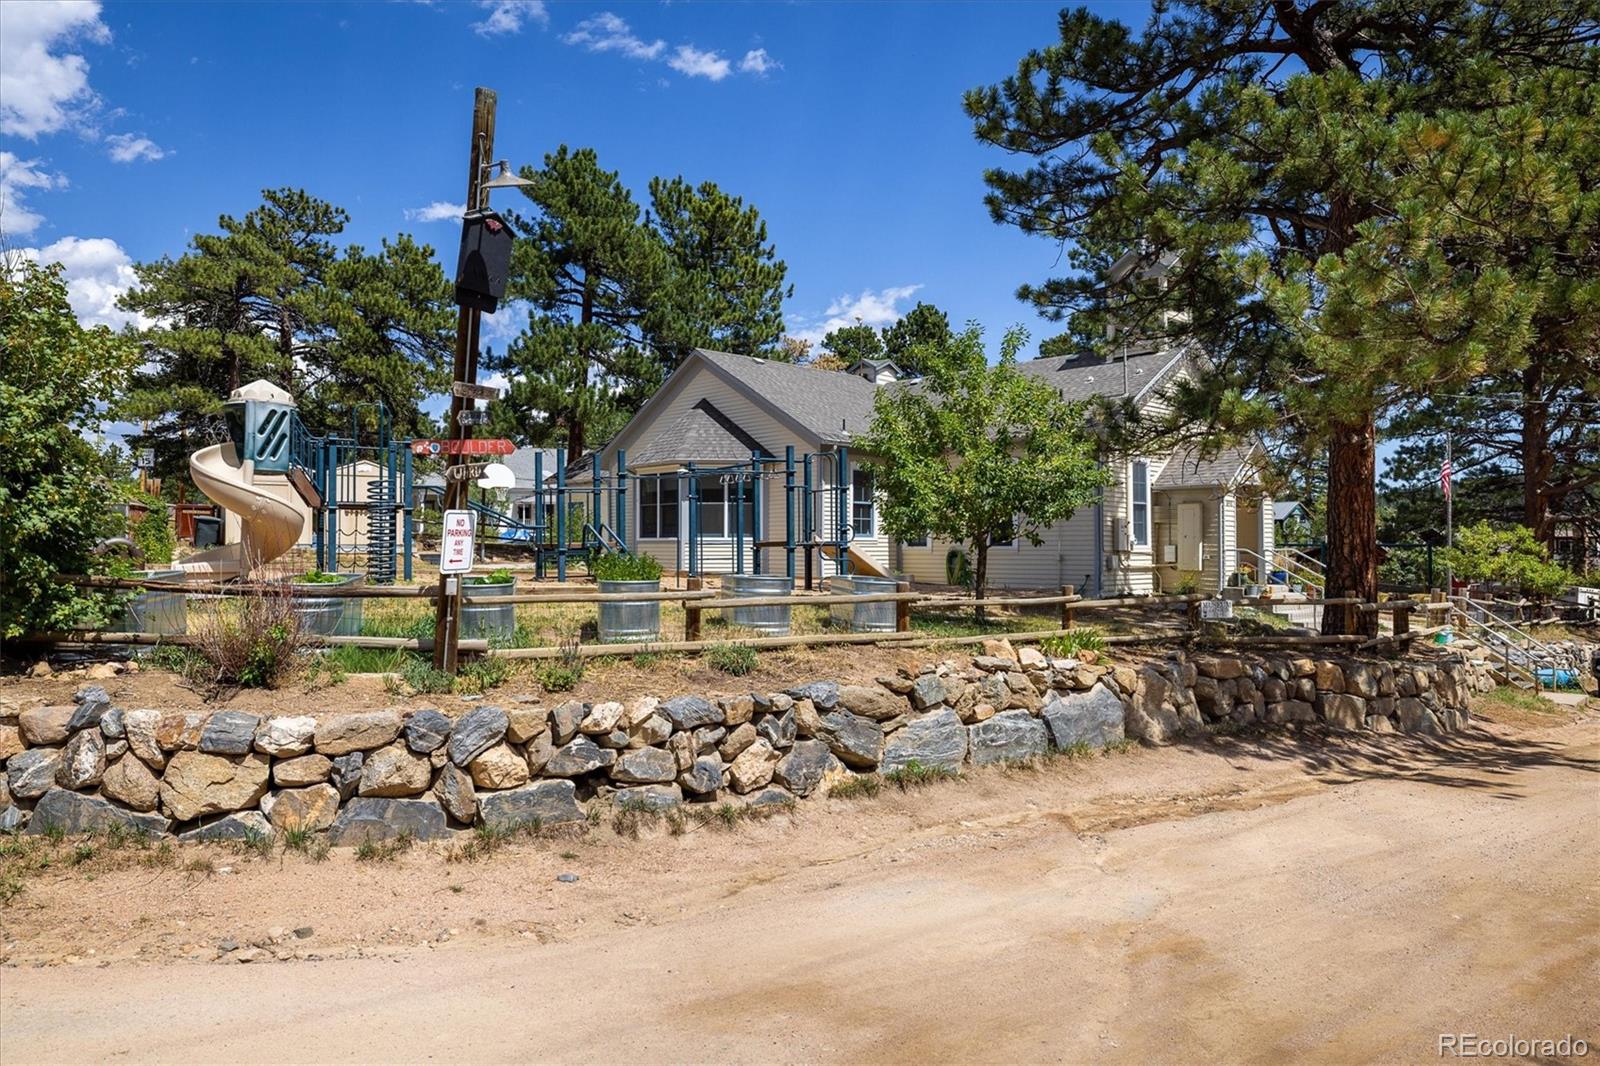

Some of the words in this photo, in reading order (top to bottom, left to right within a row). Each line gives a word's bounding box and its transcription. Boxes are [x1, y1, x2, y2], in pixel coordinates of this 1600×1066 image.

[441, 440, 506, 454] BOULDER
[456, 519, 465, 527] NO
[447, 529, 472, 537] PARKING
[453, 548, 463, 556] TIME
